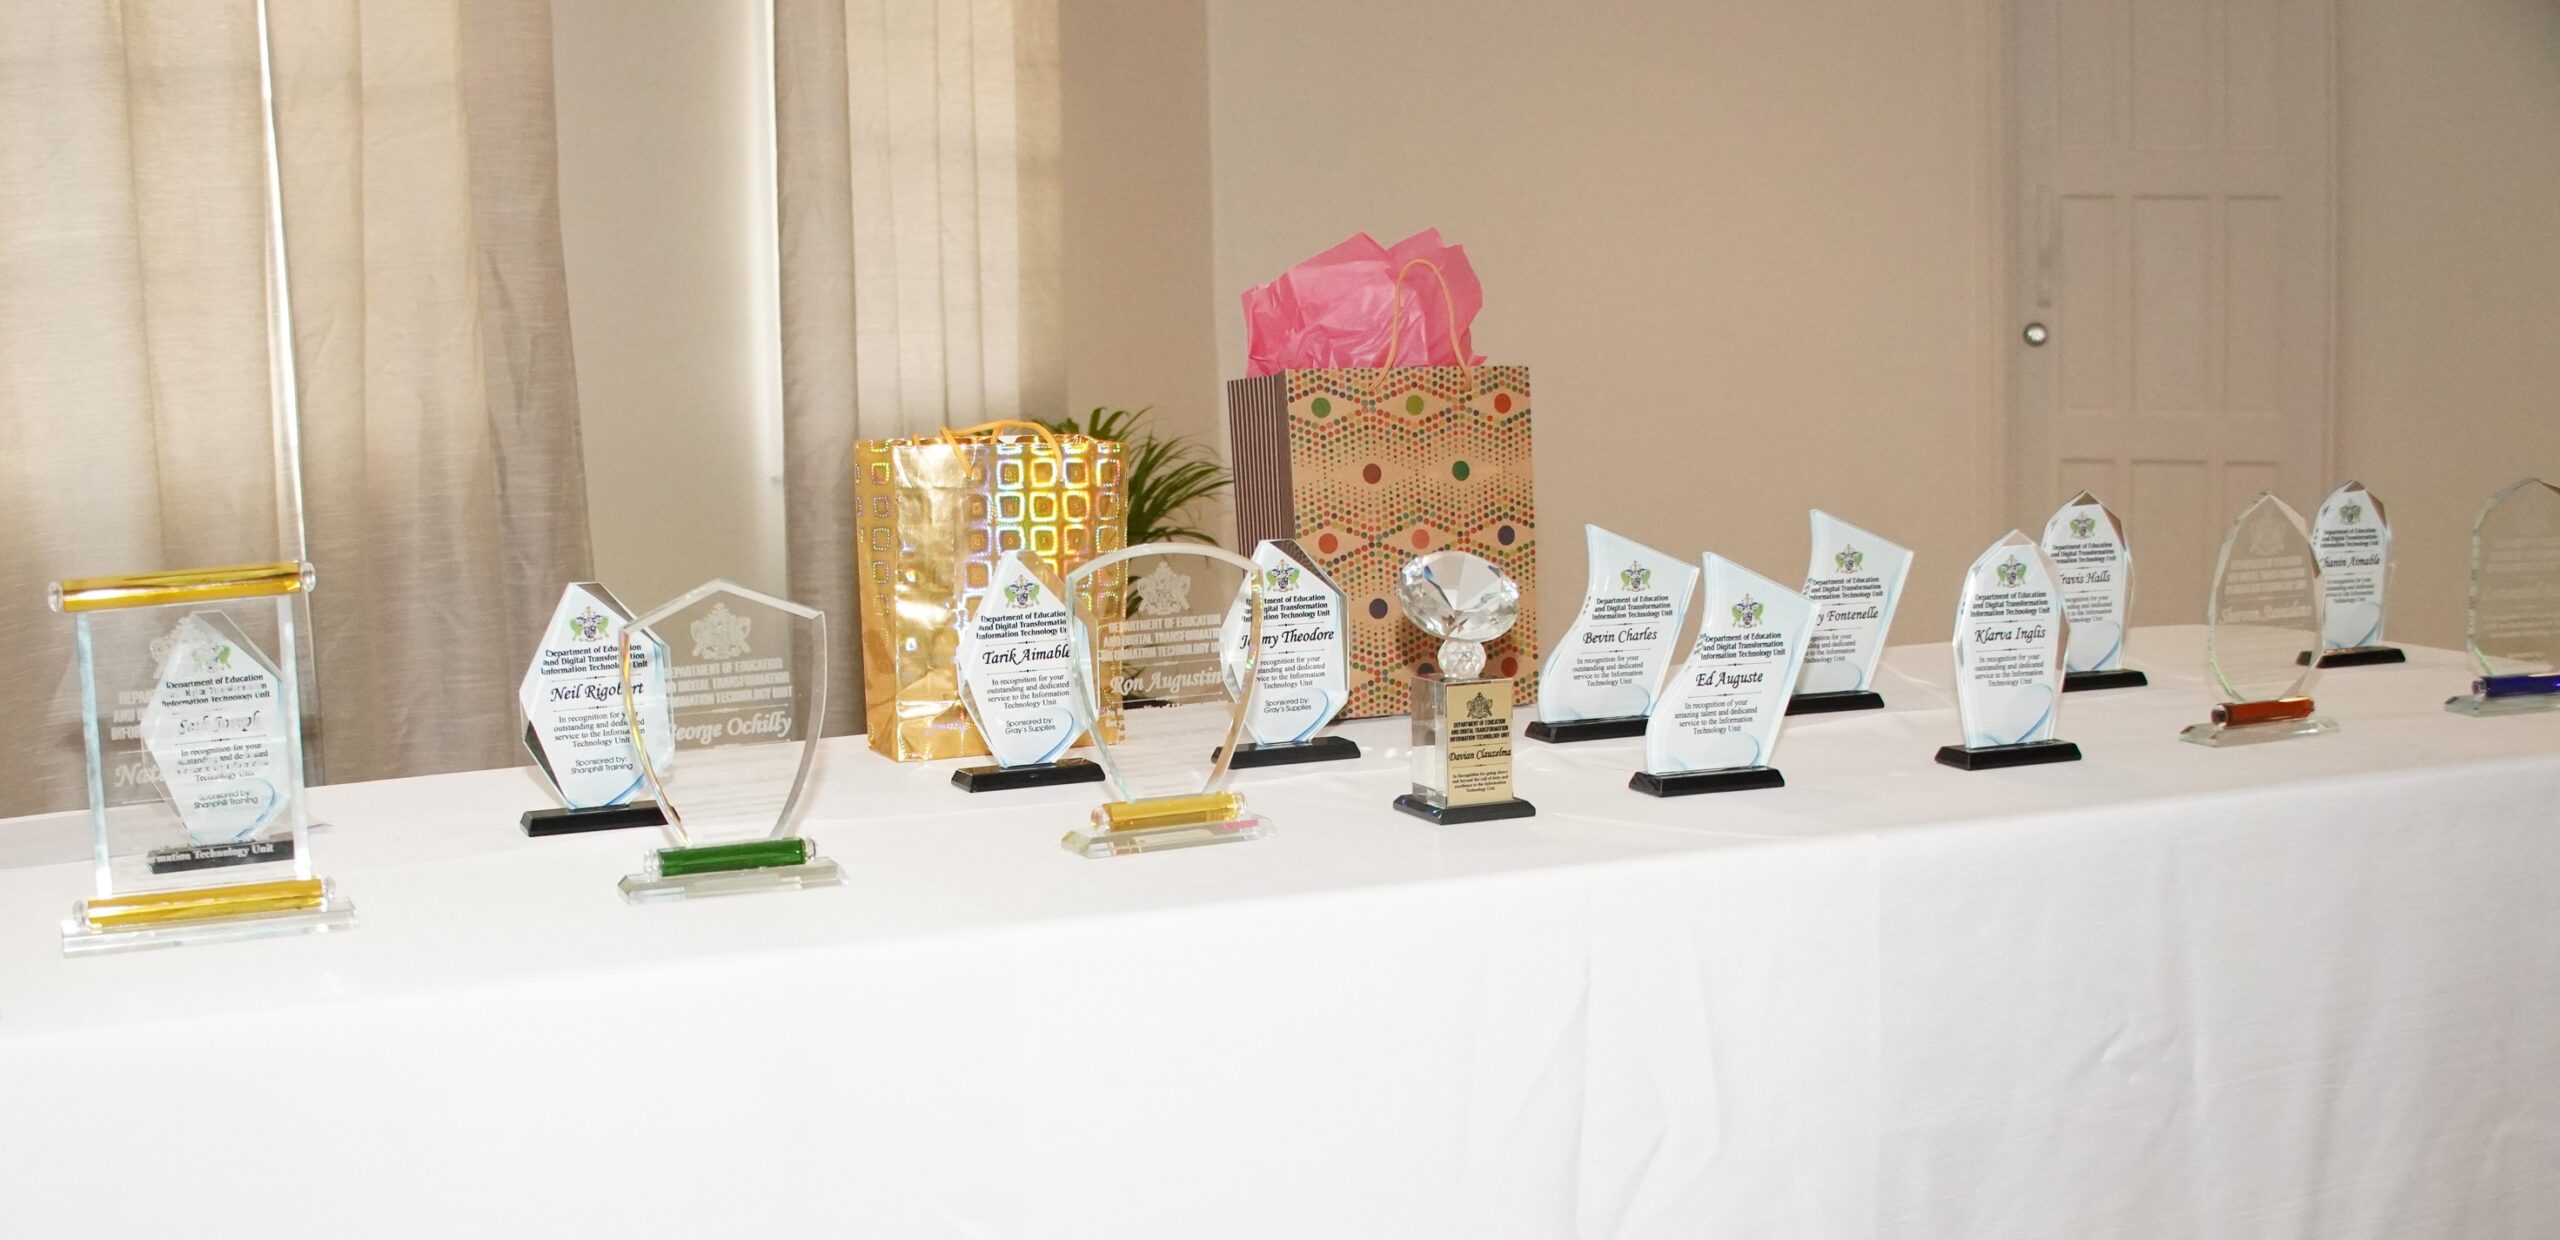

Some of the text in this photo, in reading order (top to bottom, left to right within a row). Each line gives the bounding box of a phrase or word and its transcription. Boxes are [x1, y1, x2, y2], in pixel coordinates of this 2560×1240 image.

[1813, 579, 1844, 587] Department
[2060, 571, 2111, 585] ravis Halls
[1293, 594, 1325, 602] Education
[1597, 597, 1630, 607] Department
[1975, 593, 2009, 603] Department
[1280, 602, 1328, 610] Transformation
[1607, 605, 1626, 613] Digital
[1628, 602, 1670, 610] Transformation
[1985, 601, 2004, 610] Digital
[2006, 599, 2048, 607] Transformation
[1281, 611, 1315, 621] Technology
[1628, 611, 1660, 619] Technology
[1827, 606, 1878, 621] Fontenelle
[1971, 609, 2004, 617] Information
[2006, 607, 2037, 617] Technology
[981, 613, 1023, 624] Department
[995, 622, 1018, 632] Digital
[1020, 618, 1066, 627] Transformatio
[976, 630, 1018, 640] Information
[1020, 627, 1058, 638] Technology
[1282, 626, 1334, 643] Theodore
[1583, 628, 1657, 644] Bevin Charles
[1705, 635, 1742, 644] Department
[1751, 632, 1781, 640] Education
[1975, 624, 2046, 645] Klarva Inglis
[546, 647, 592, 659] Department
[604, 643, 641, 652] Eduion
[1716, 643, 1736, 652] Digital
[1738, 640, 1783, 649] Transformation
[562, 657, 585, 666] Digital
[589, 652, 644, 662] Transfortion
[982, 648, 1021, 665] Tarik
[1701, 652, 1736, 660] Information
[1739, 649, 1772, 659] Technology
[1584, 657, 1615, 665] recognition
[541, 665, 586, 675] Information
[1572, 665, 1604, 673] outstanding
[226, 673, 263, 683] Education
[1001, 676, 1036, 686] recognition
[1587, 679, 1618, 688] Technology
[1696, 671, 1763, 687] Ed Auguste
[987, 685, 1024, 696] outstanding
[1039, 682, 1069, 690] dedicated
[1110, 677, 1144, 695] Ron
[550, 683, 644, 702] Neil Rigobrt
[1032, 690, 1069, 698] Information
[1004, 700, 1040, 711] Technology
[1692, 701, 1725, 710] recognition
[569, 713, 607, 724] recognition
[1675, 711, 1699, 720] amazing
[1719, 716, 1752, 724] Information
[554, 722, 594, 734] outstanding
[1693, 726, 1726, 736] Technology
[555, 732, 579, 740] service
[673, 725, 722, 744] eorge
[573, 738, 612, 749] Technology
[193, 843, 275, 860] Technology Unit
